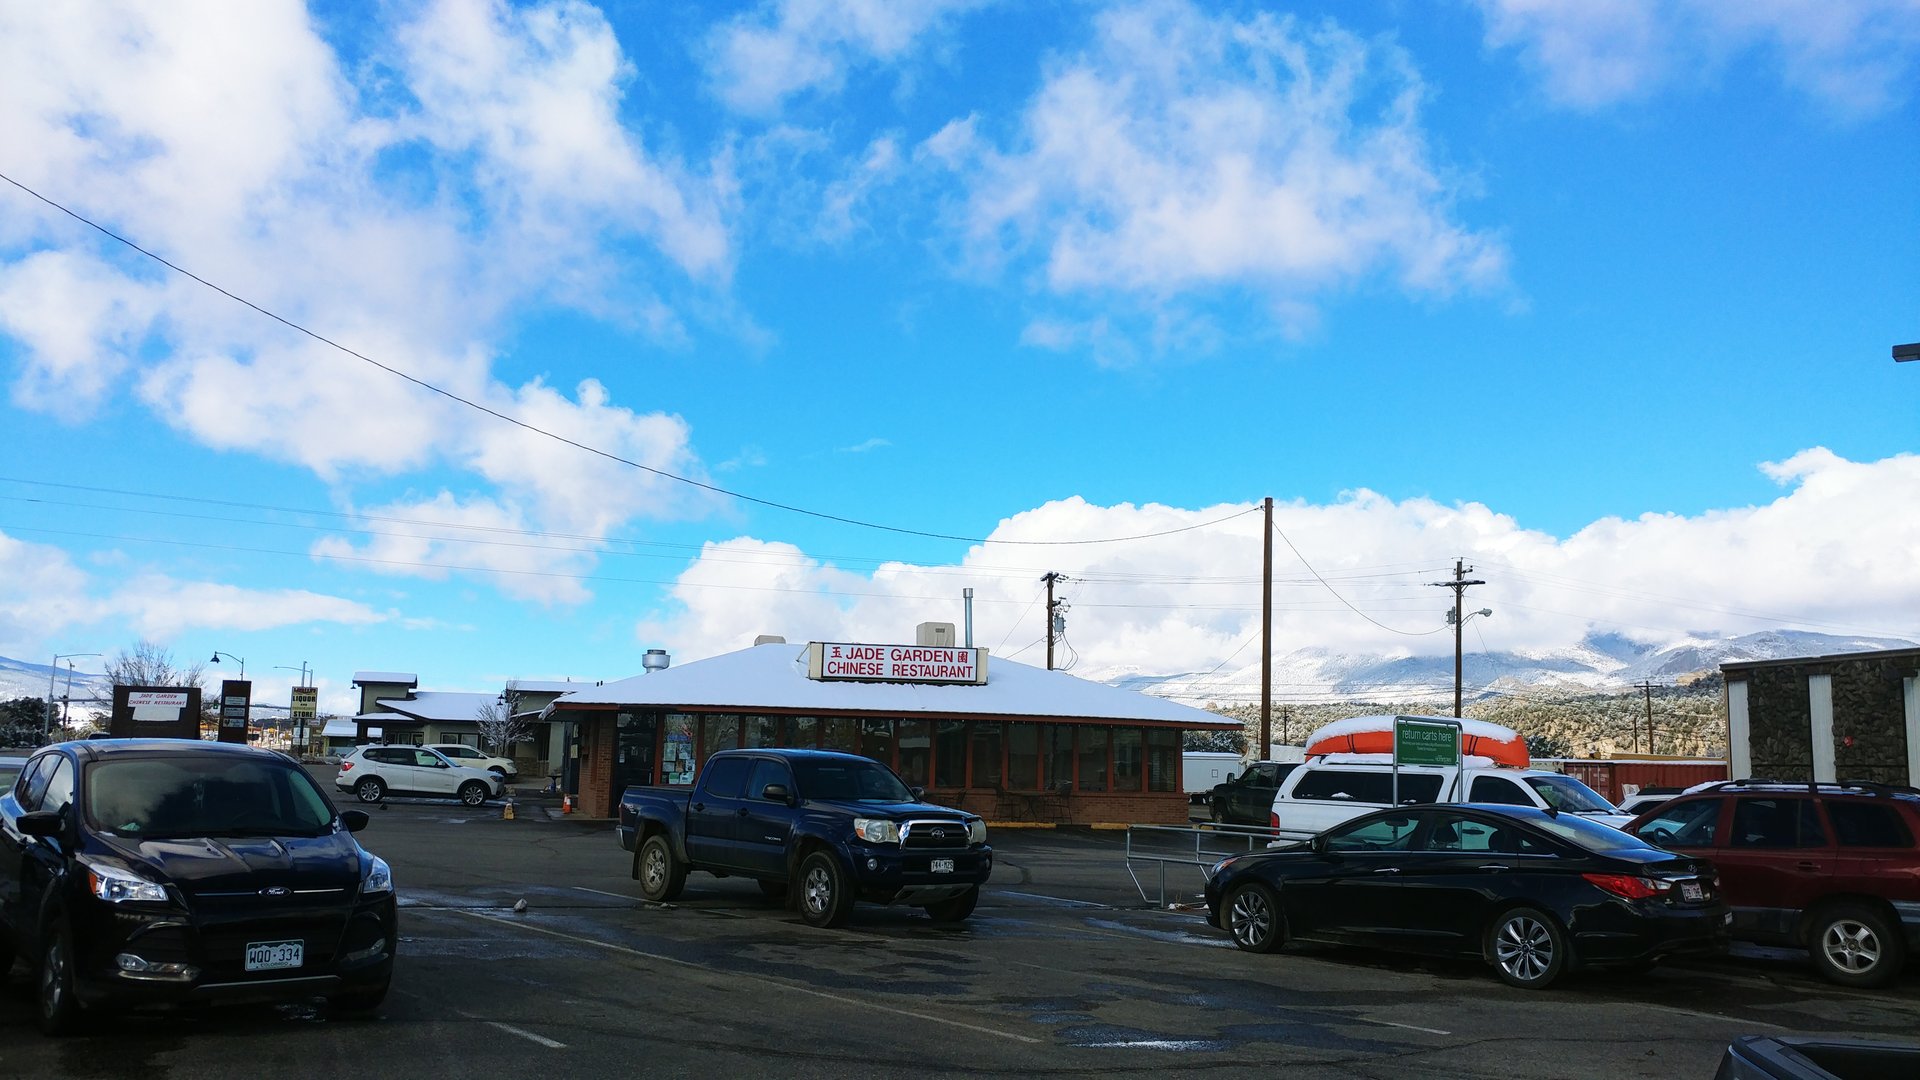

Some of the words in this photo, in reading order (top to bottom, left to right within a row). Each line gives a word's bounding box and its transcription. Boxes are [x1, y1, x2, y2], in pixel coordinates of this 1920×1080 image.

[846, 647, 885, 661] JADE
[890, 648, 953, 663] GARDEN
[827, 661, 884, 676] CHINESE
[892, 663, 973, 678] RESTAURANT
[292, 695, 316, 703] LIQUOR
[1402, 729, 1421, 740] return
[1422, 730, 1437, 741] carts
[1438, 730, 1452, 742] here
